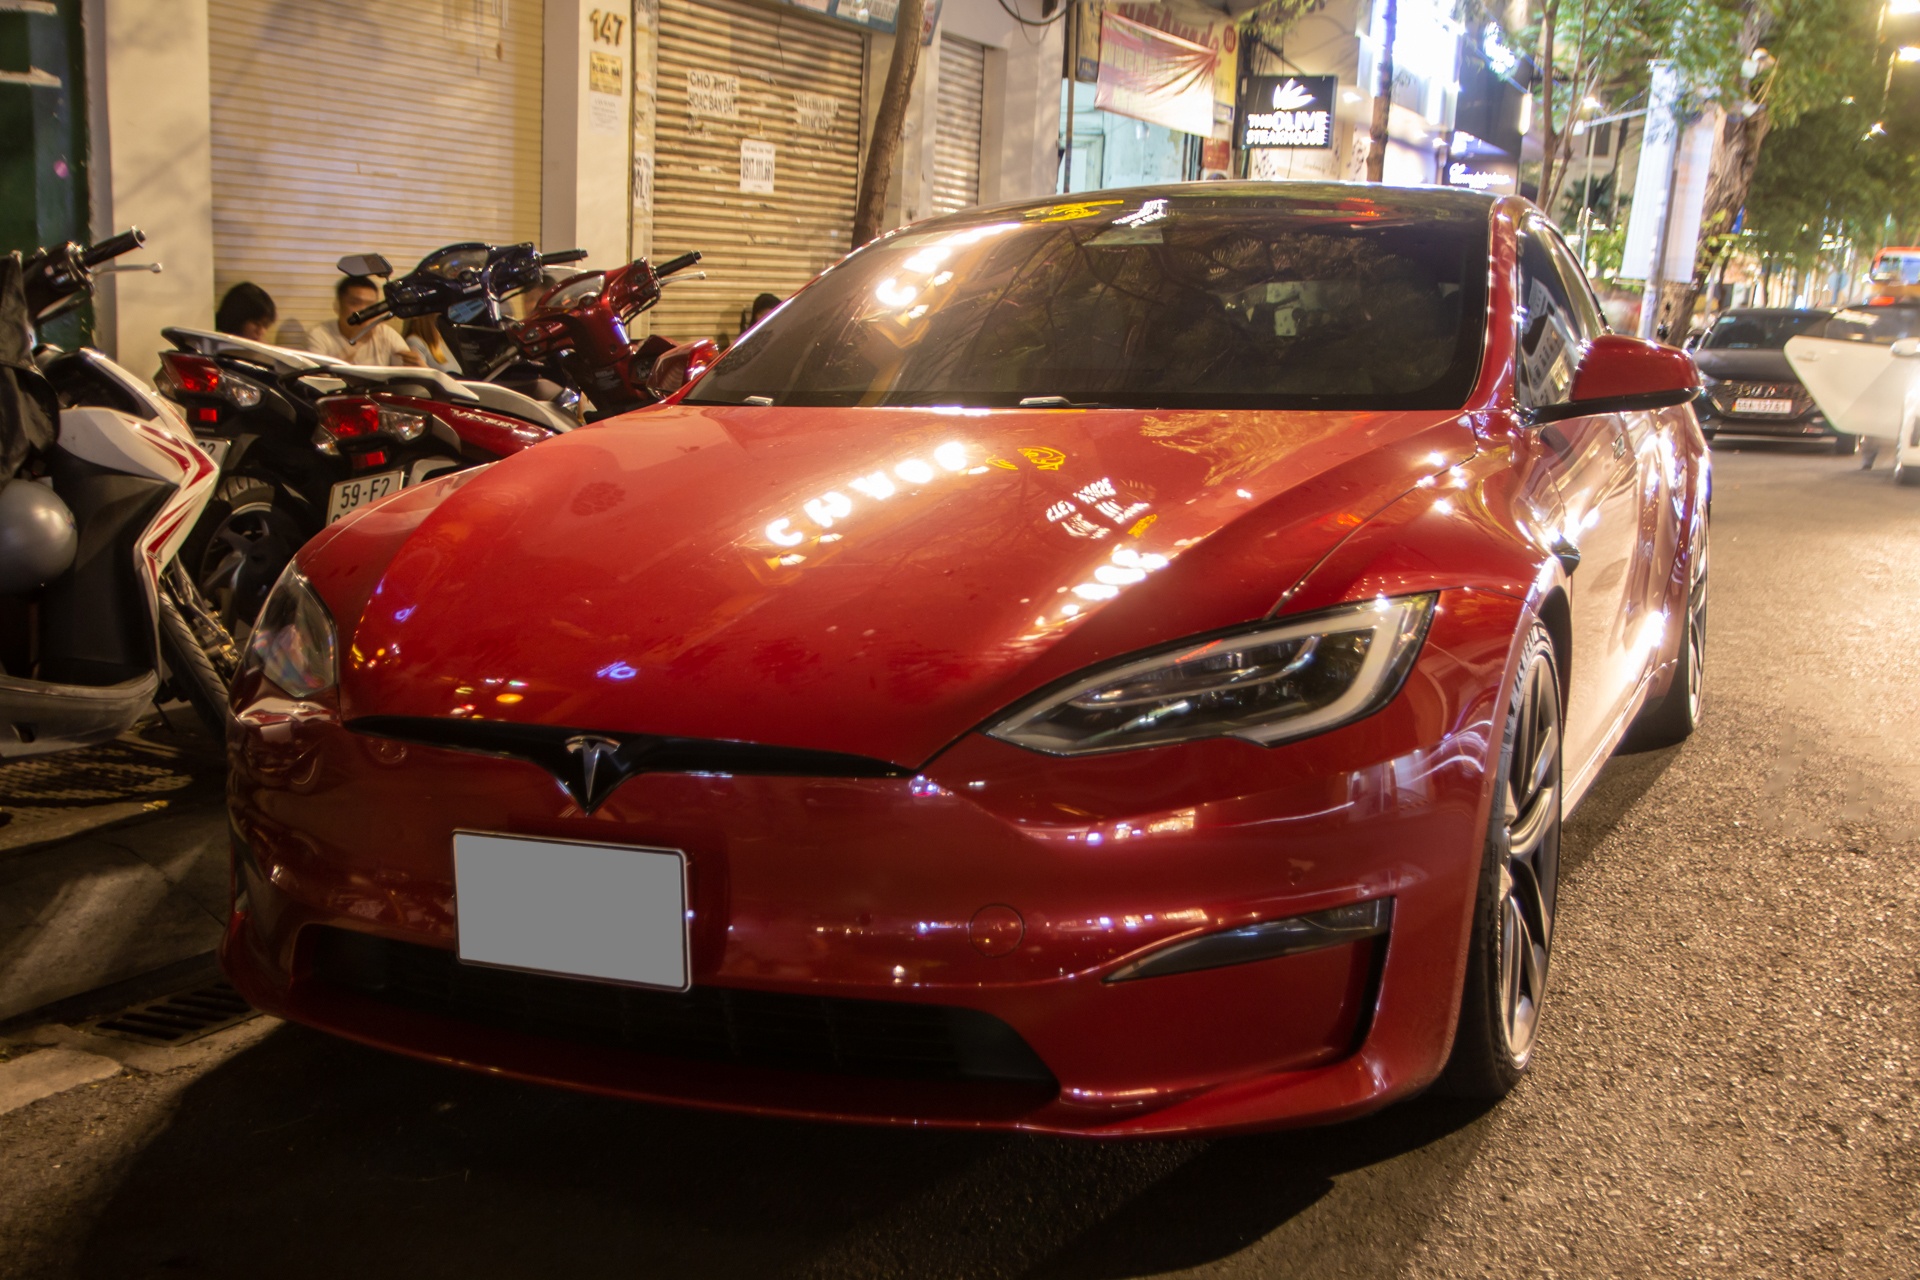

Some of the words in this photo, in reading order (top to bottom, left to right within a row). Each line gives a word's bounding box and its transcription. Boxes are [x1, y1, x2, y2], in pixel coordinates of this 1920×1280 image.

[589, 8, 627, 47] 147
[1272, 111, 1328, 131] OLIVE
[1246, 129, 1326, 145] STEAKHOUSE
